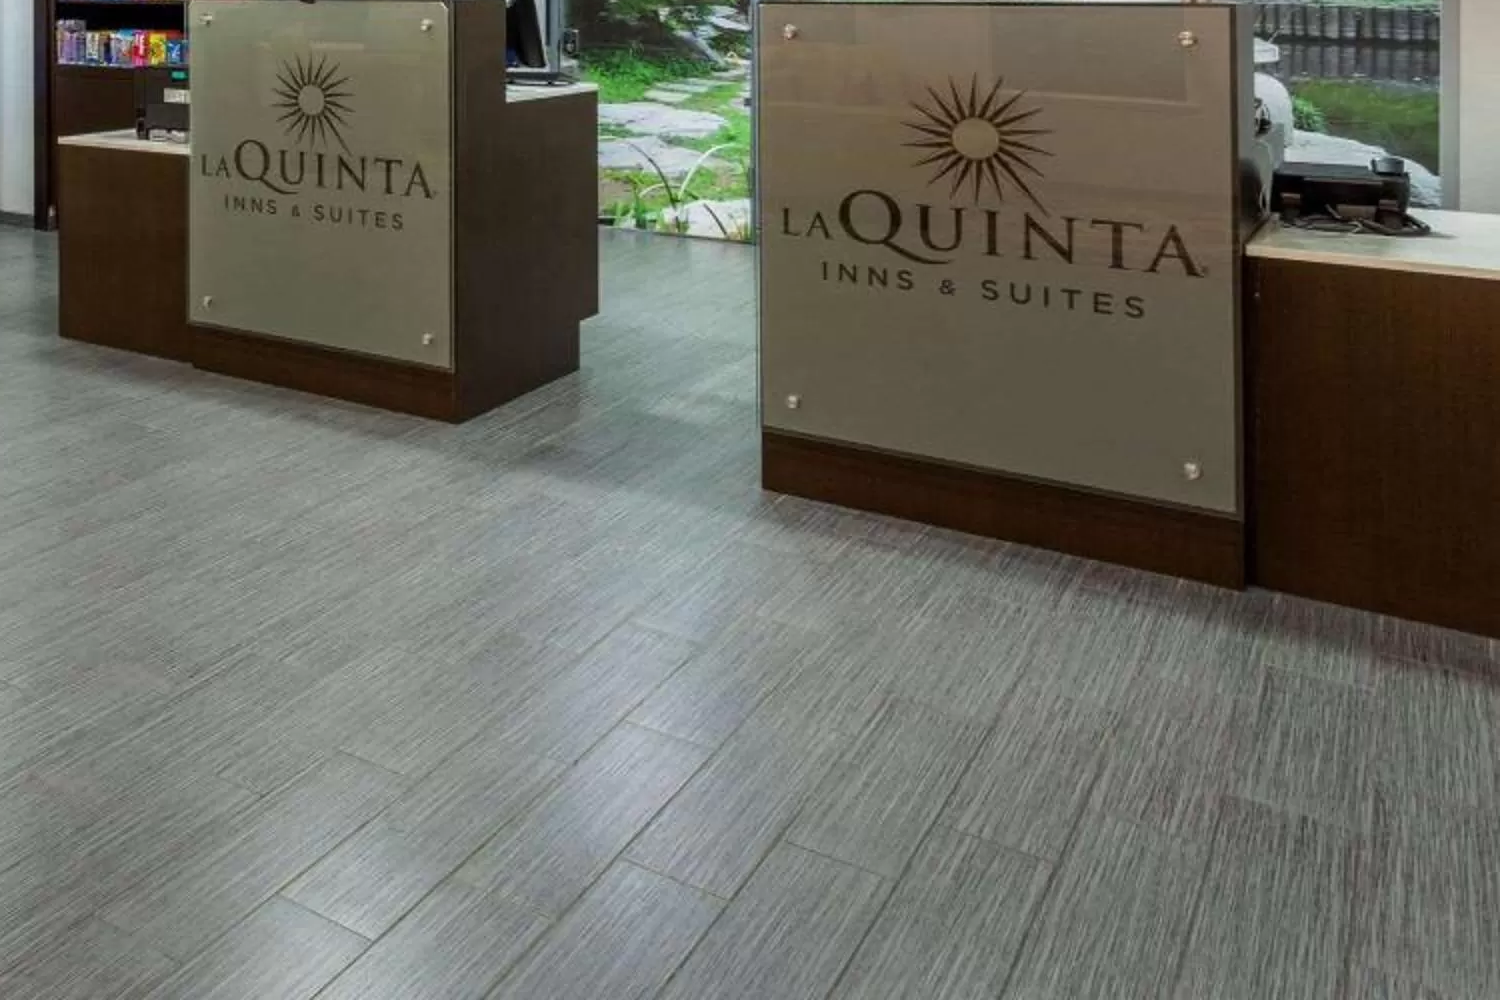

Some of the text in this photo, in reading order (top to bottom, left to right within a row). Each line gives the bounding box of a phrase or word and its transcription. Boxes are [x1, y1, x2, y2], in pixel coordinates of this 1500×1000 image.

[201, 139, 433, 200] LA QUINTA
[224, 194, 404, 231] INNS & SUITES
[782, 189, 1205, 279] LA QUINTA
[821, 261, 1146, 319] INNS & SUITES
